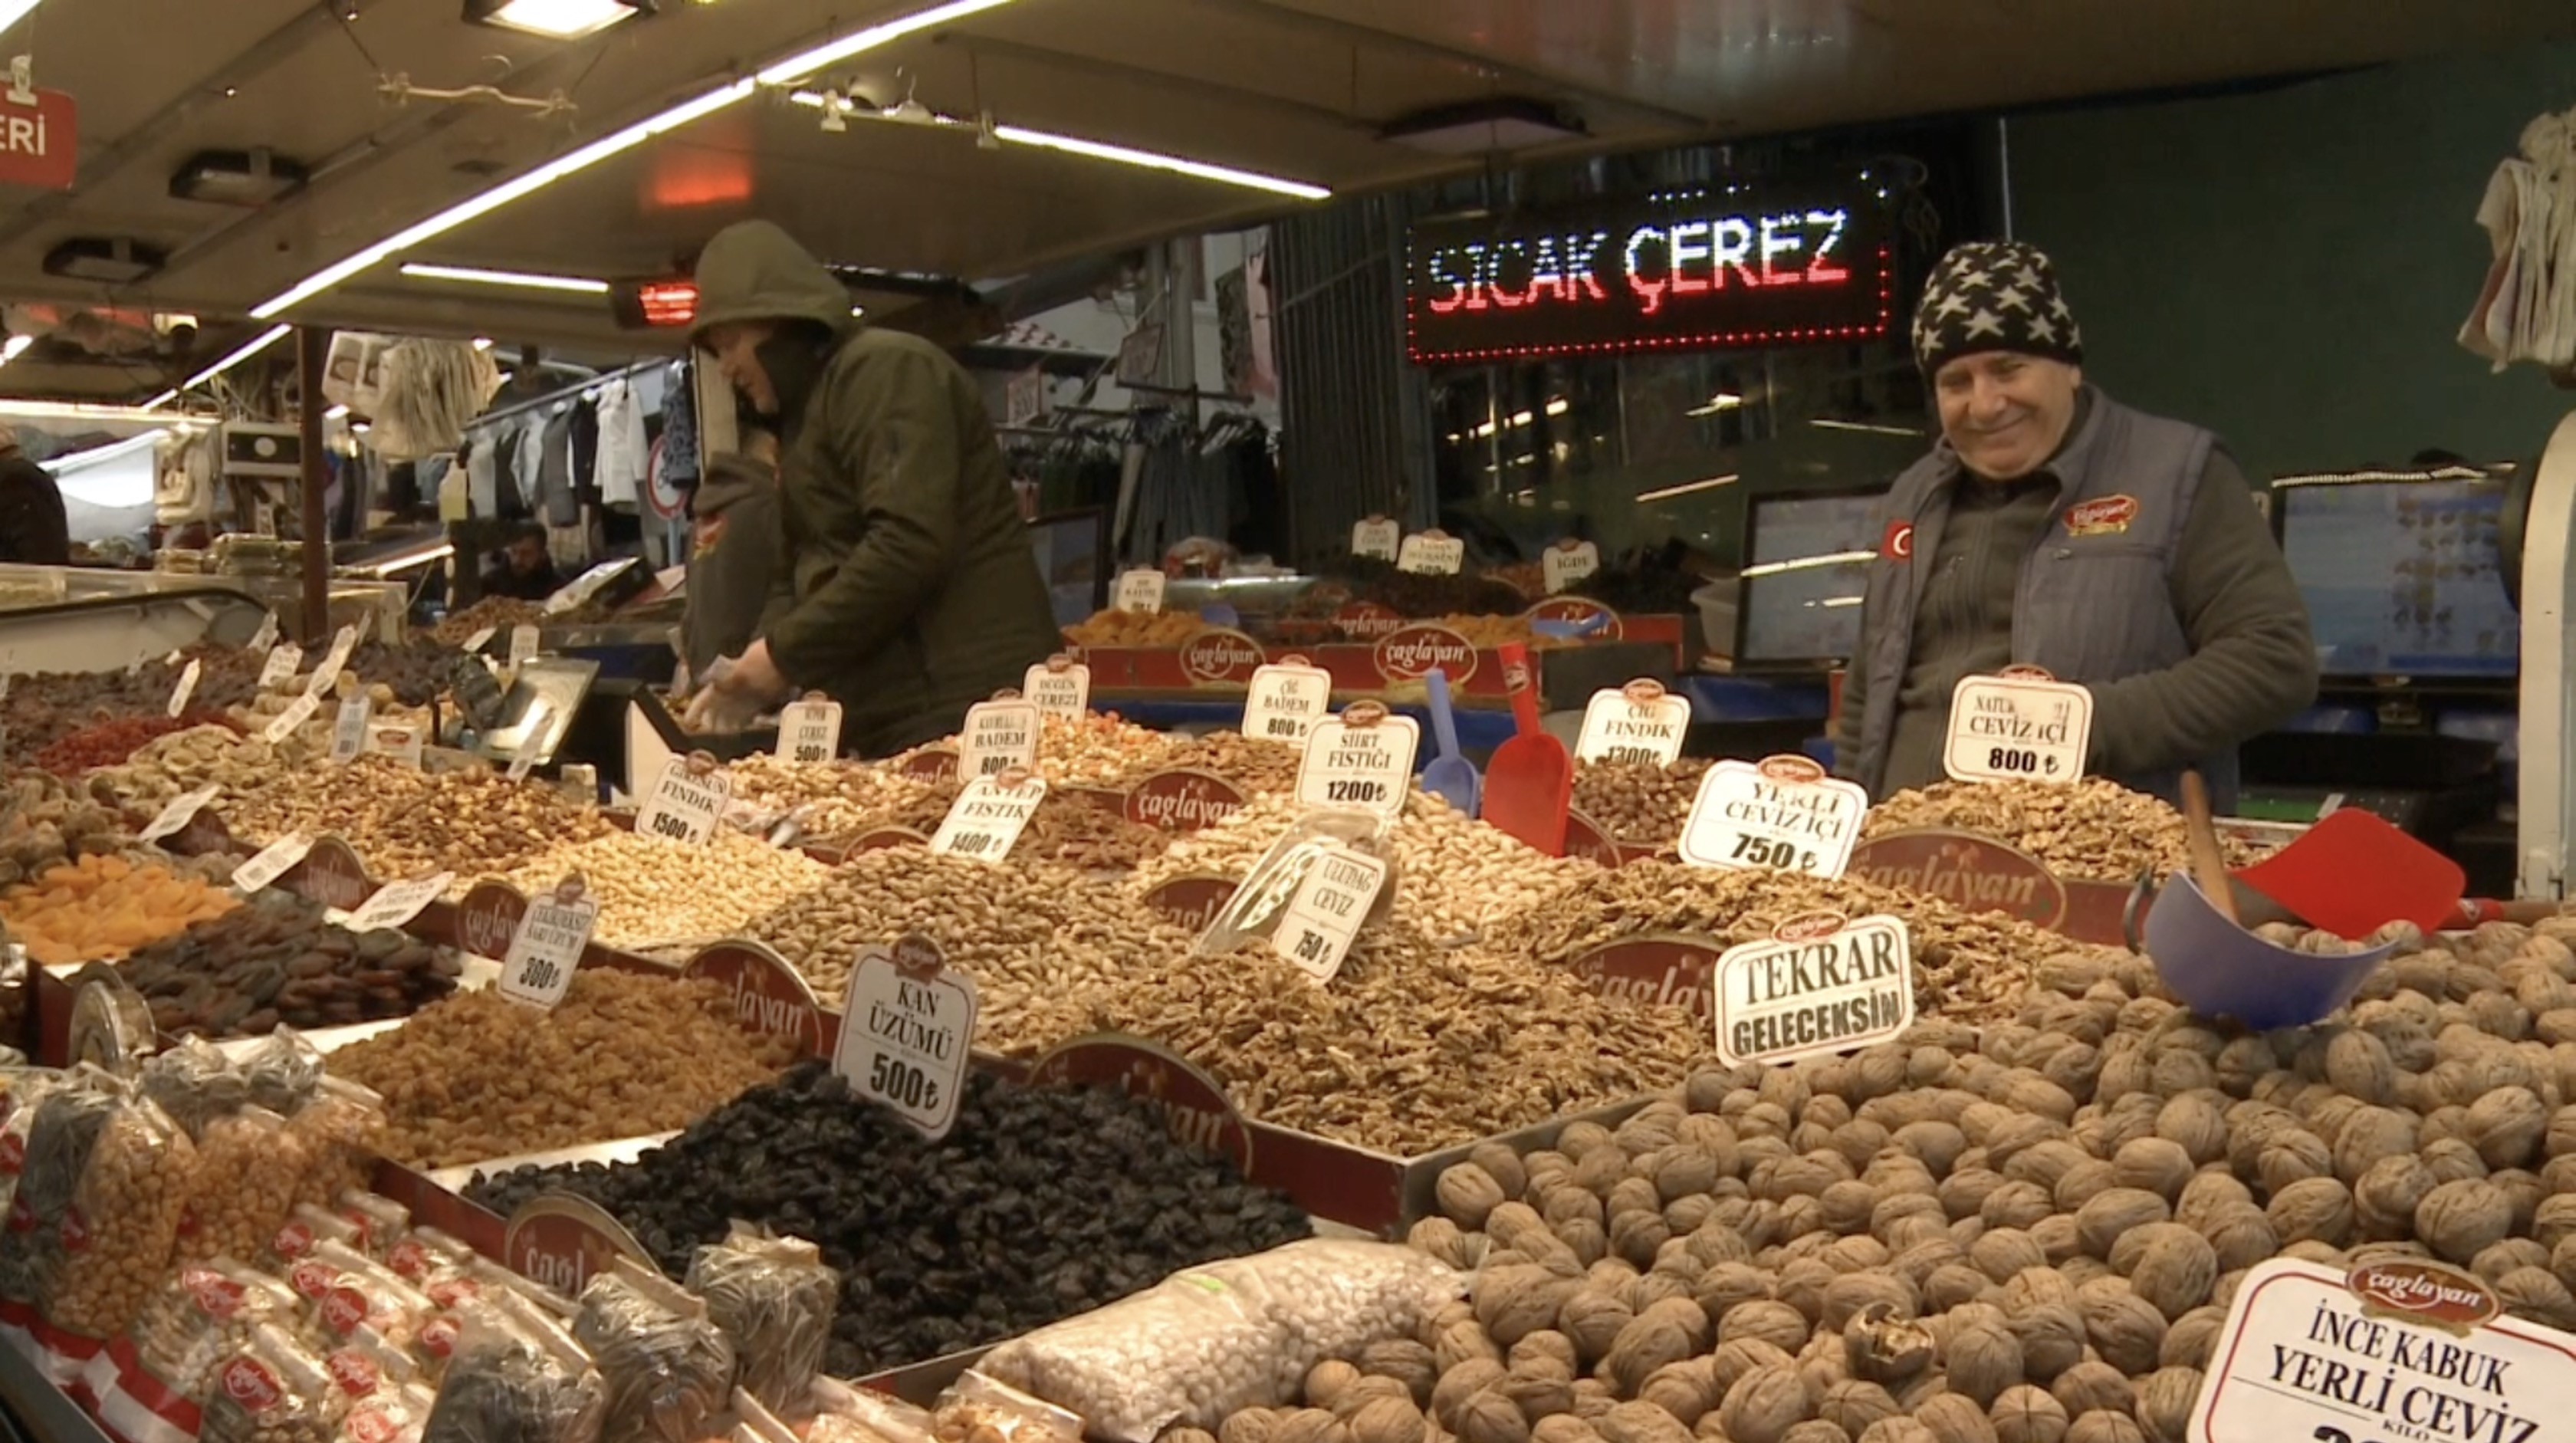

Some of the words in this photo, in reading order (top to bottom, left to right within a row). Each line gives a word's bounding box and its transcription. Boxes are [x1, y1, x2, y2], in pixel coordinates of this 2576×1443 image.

[1429, 231, 1608, 312] SICAK
[1624, 208, 1848, 314] ÇEREZ
[975, 731, 1025, 748] BADEM
[1605, 719, 1675, 740] FINDIK
[1970, 714, 2033, 738] CEVİZ
[1988, 748, 2038, 773] 800
[1726, 800, 1802, 830] CEVİZ
[1753, 782, 1841, 814] YERLİ
[1730, 832, 1796, 869] 750
[1740, 931, 1898, 1006] TEKRAR
[897, 981, 940, 1018] KAN
[869, 999, 954, 1061] ÜZÜMÜ
[1733, 988, 1901, 1057] GELECEKSİN
[2306, 1298, 2388, 1360] İNCE
[2388, 1330, 2515, 1396] KABUK
[2269, 1343, 2396, 1414] YERLİ
[2401, 1385, 2541, 1443] CEVİZ
